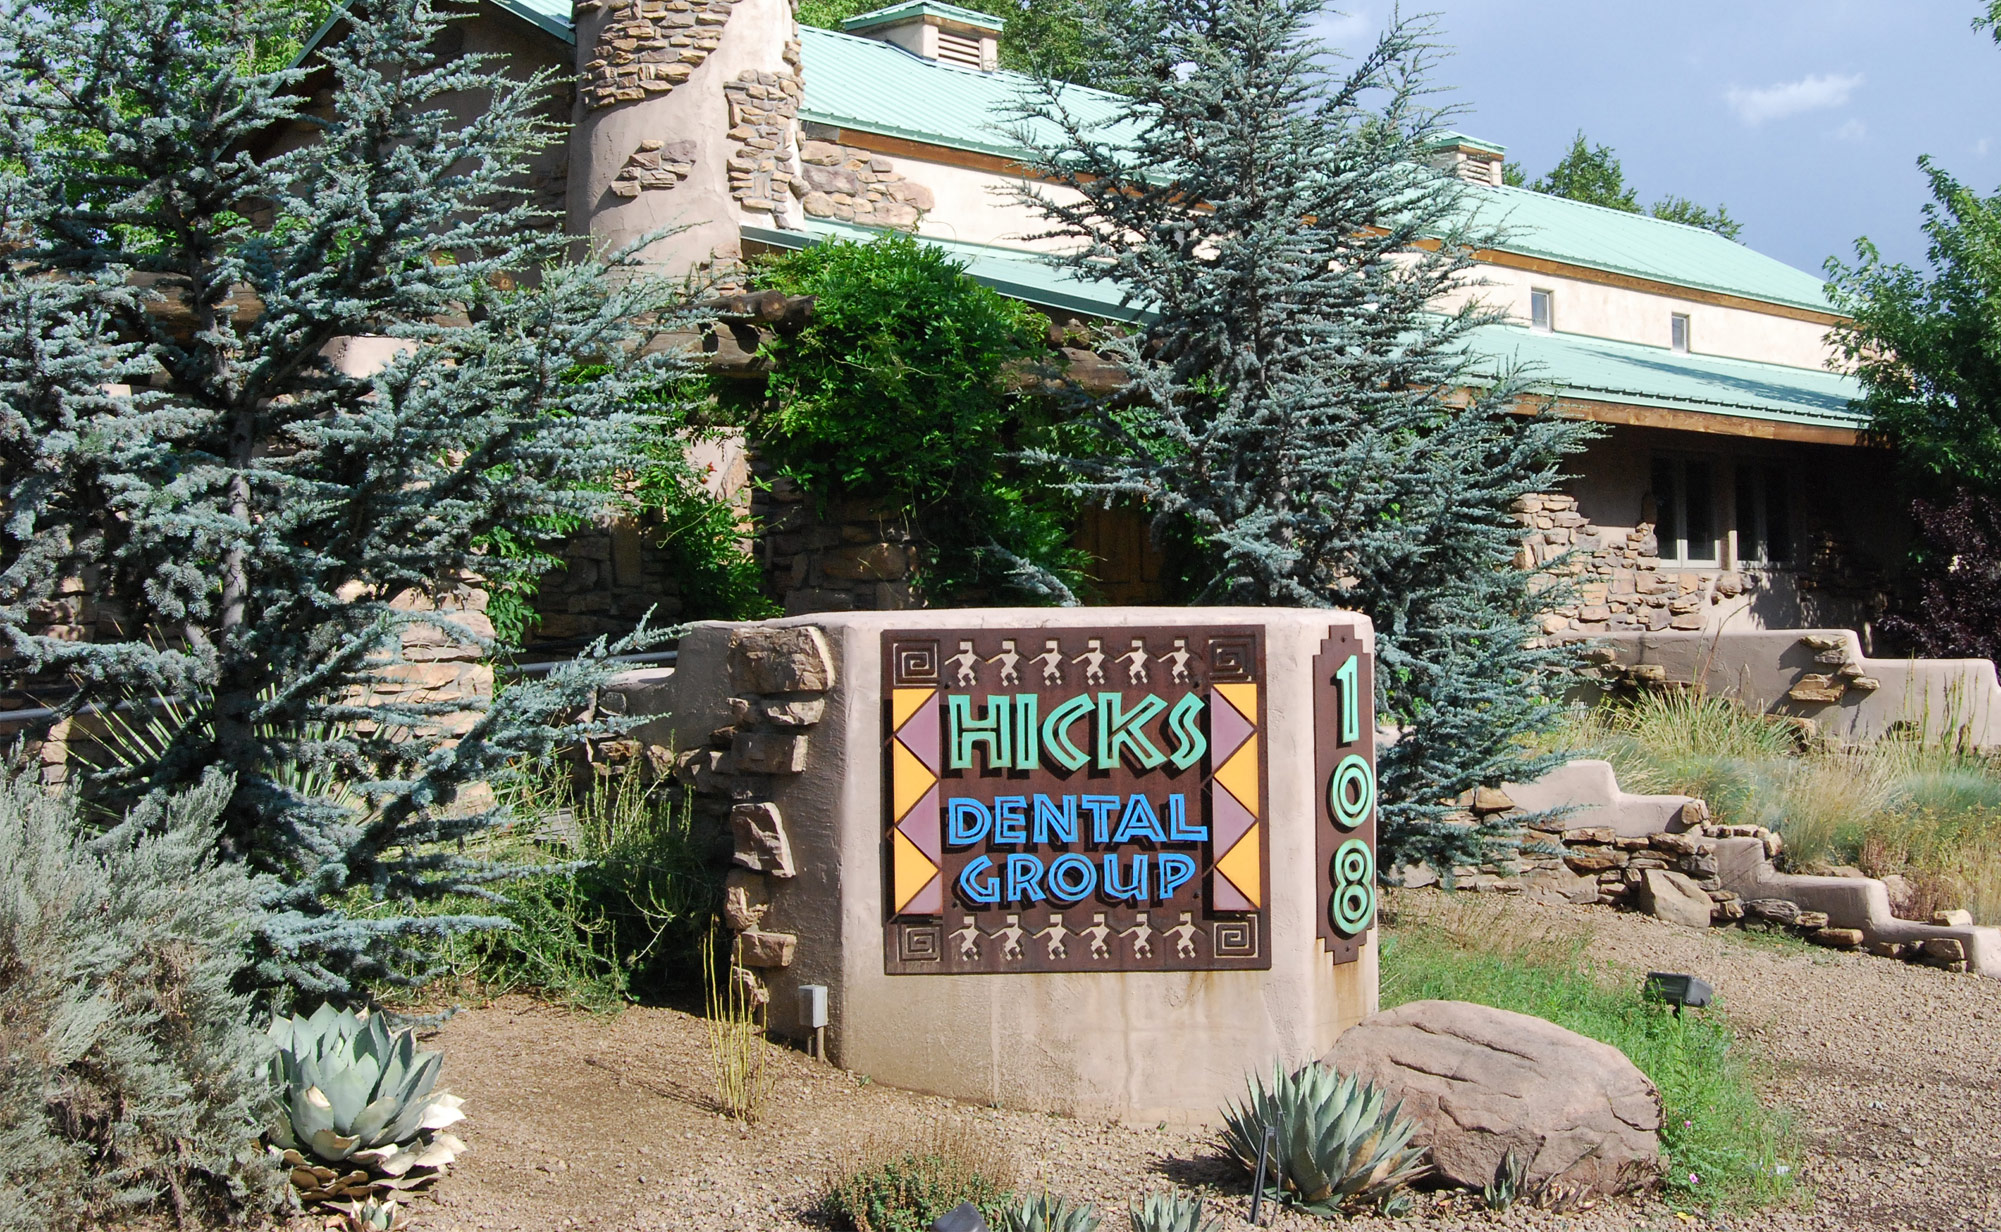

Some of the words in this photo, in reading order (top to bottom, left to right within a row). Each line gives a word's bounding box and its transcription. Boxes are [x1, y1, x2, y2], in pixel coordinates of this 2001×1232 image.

[947, 692, 1208, 771] HICKS
[948, 794, 1208, 845] DENTAL
[1331, 655, 1374, 935] 108
[959, 853, 1196, 902] GROUP
